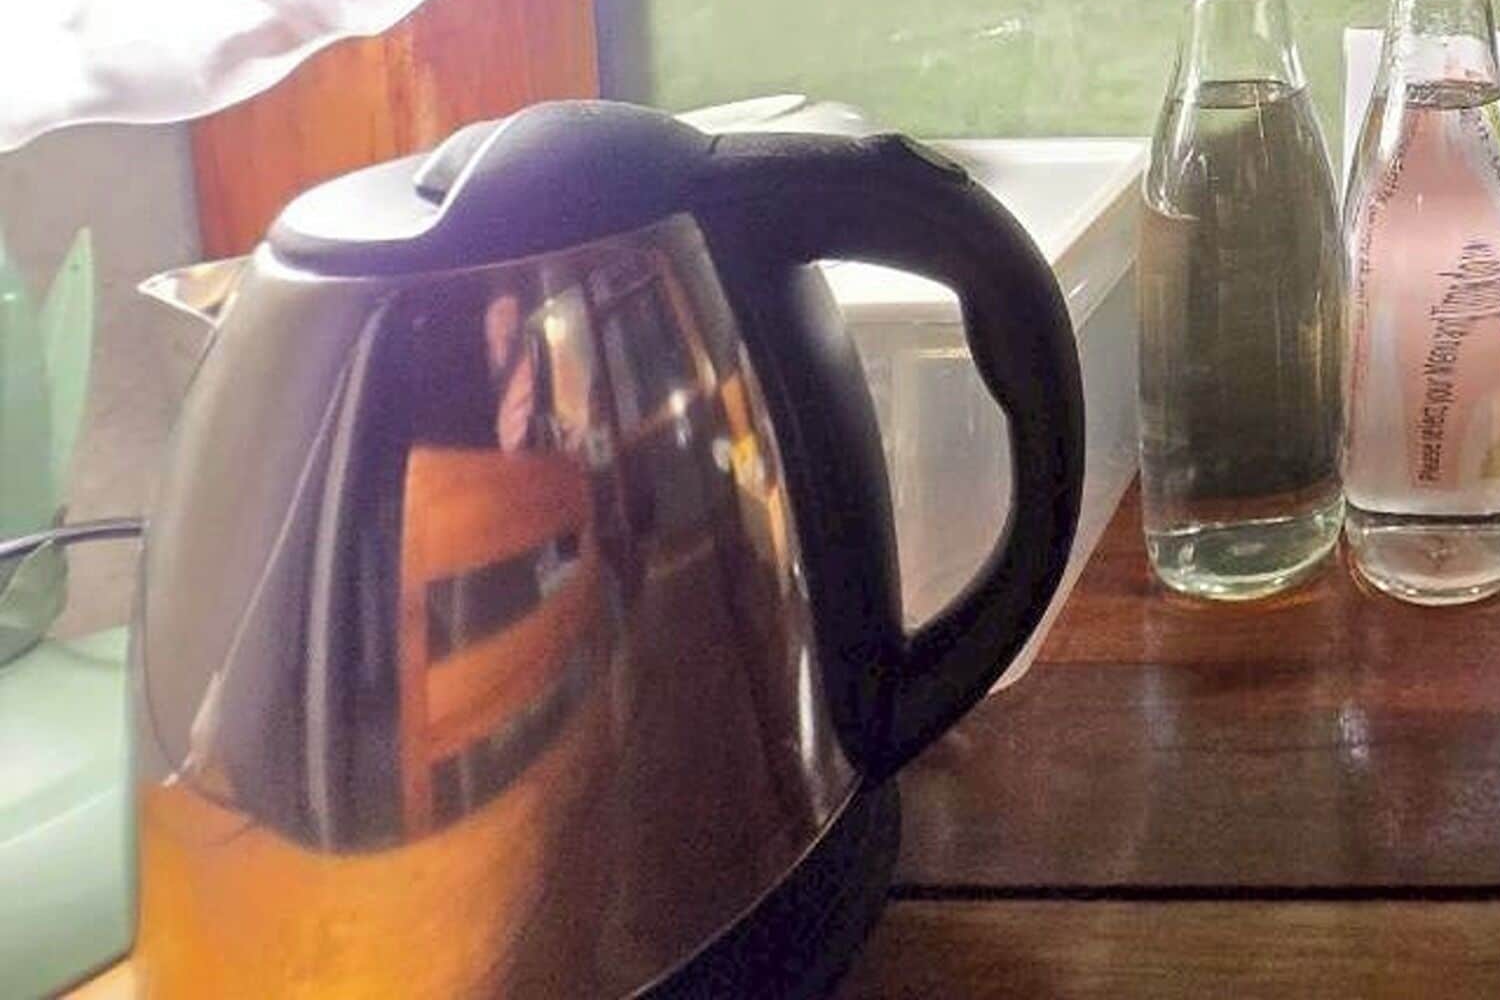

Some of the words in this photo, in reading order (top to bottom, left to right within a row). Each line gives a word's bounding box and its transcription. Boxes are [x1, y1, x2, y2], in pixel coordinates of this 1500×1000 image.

[1425, 339, 1459, 376] Menu
[1427, 379, 1455, 405] your
[1418, 406, 1446, 442] select
[1418, 443, 1441, 482] Please
